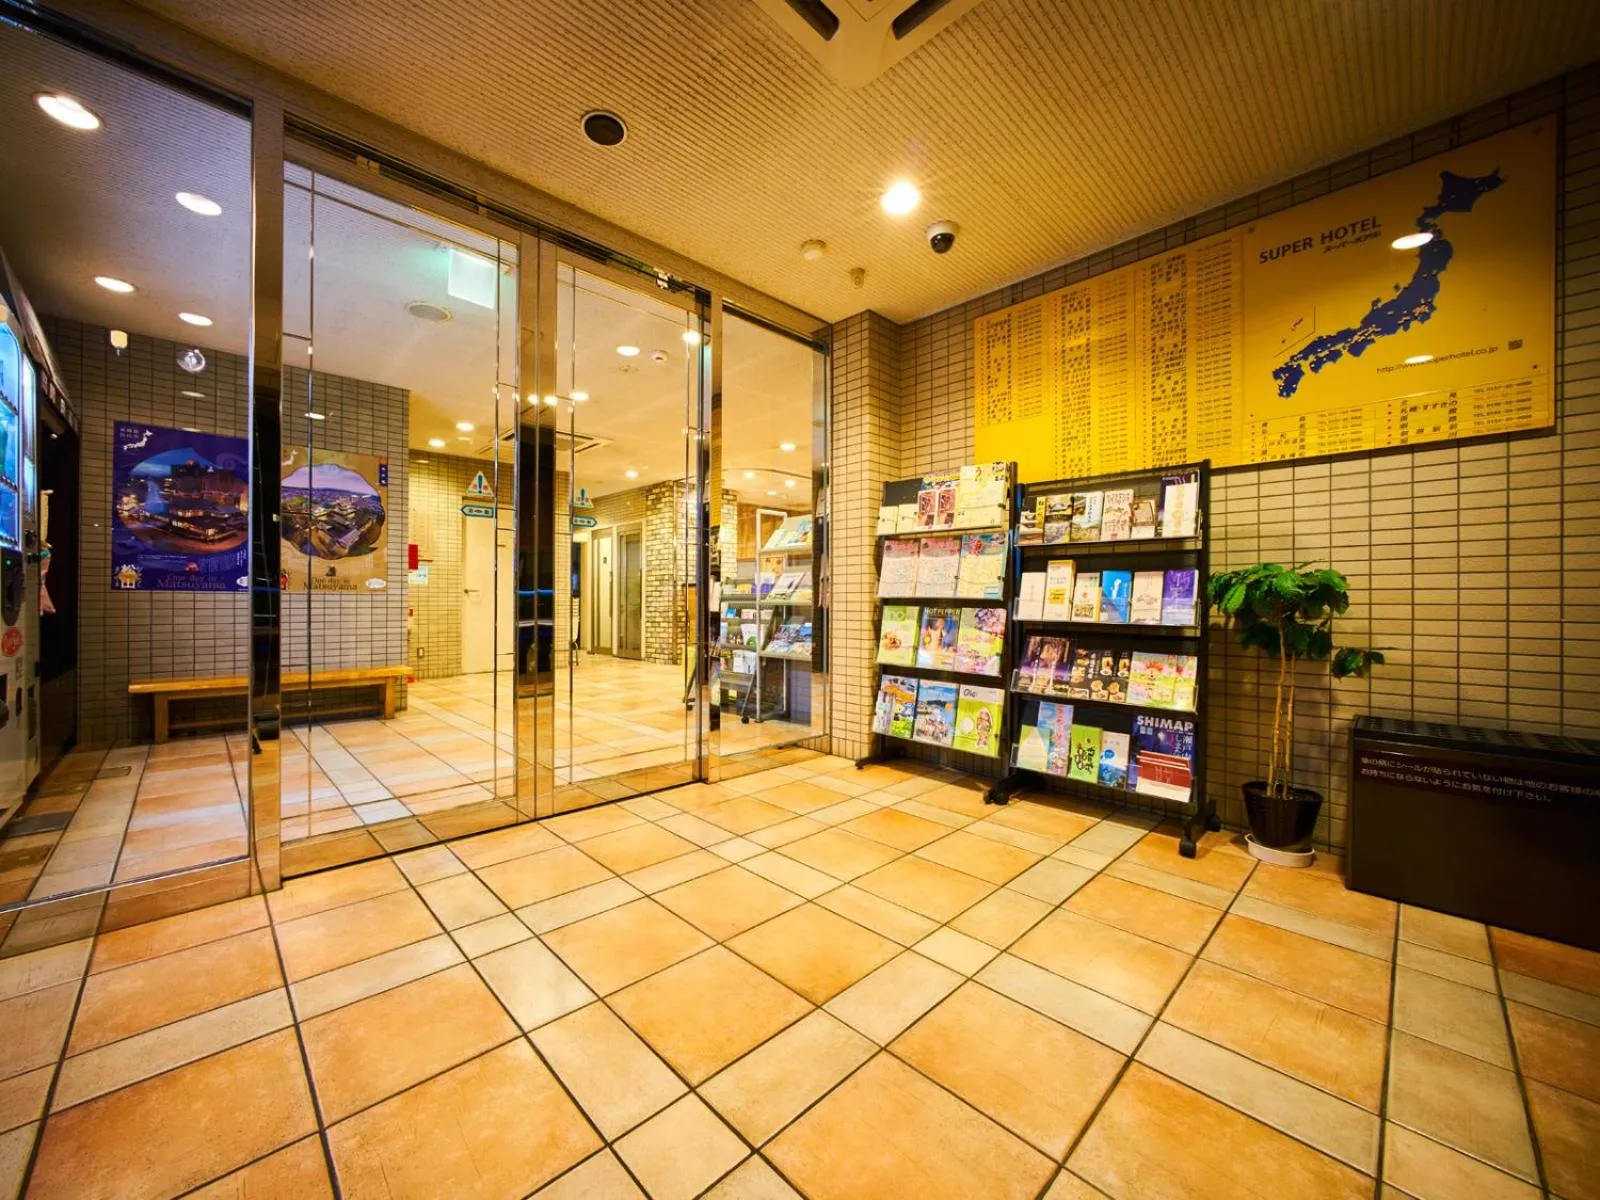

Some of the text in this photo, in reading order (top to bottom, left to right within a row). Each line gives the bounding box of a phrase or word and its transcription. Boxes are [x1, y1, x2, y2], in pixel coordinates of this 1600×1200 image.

[1259, 216, 1382, 264] SUPER HOTEL
[1137, 715, 1194, 732] SHIMAP
